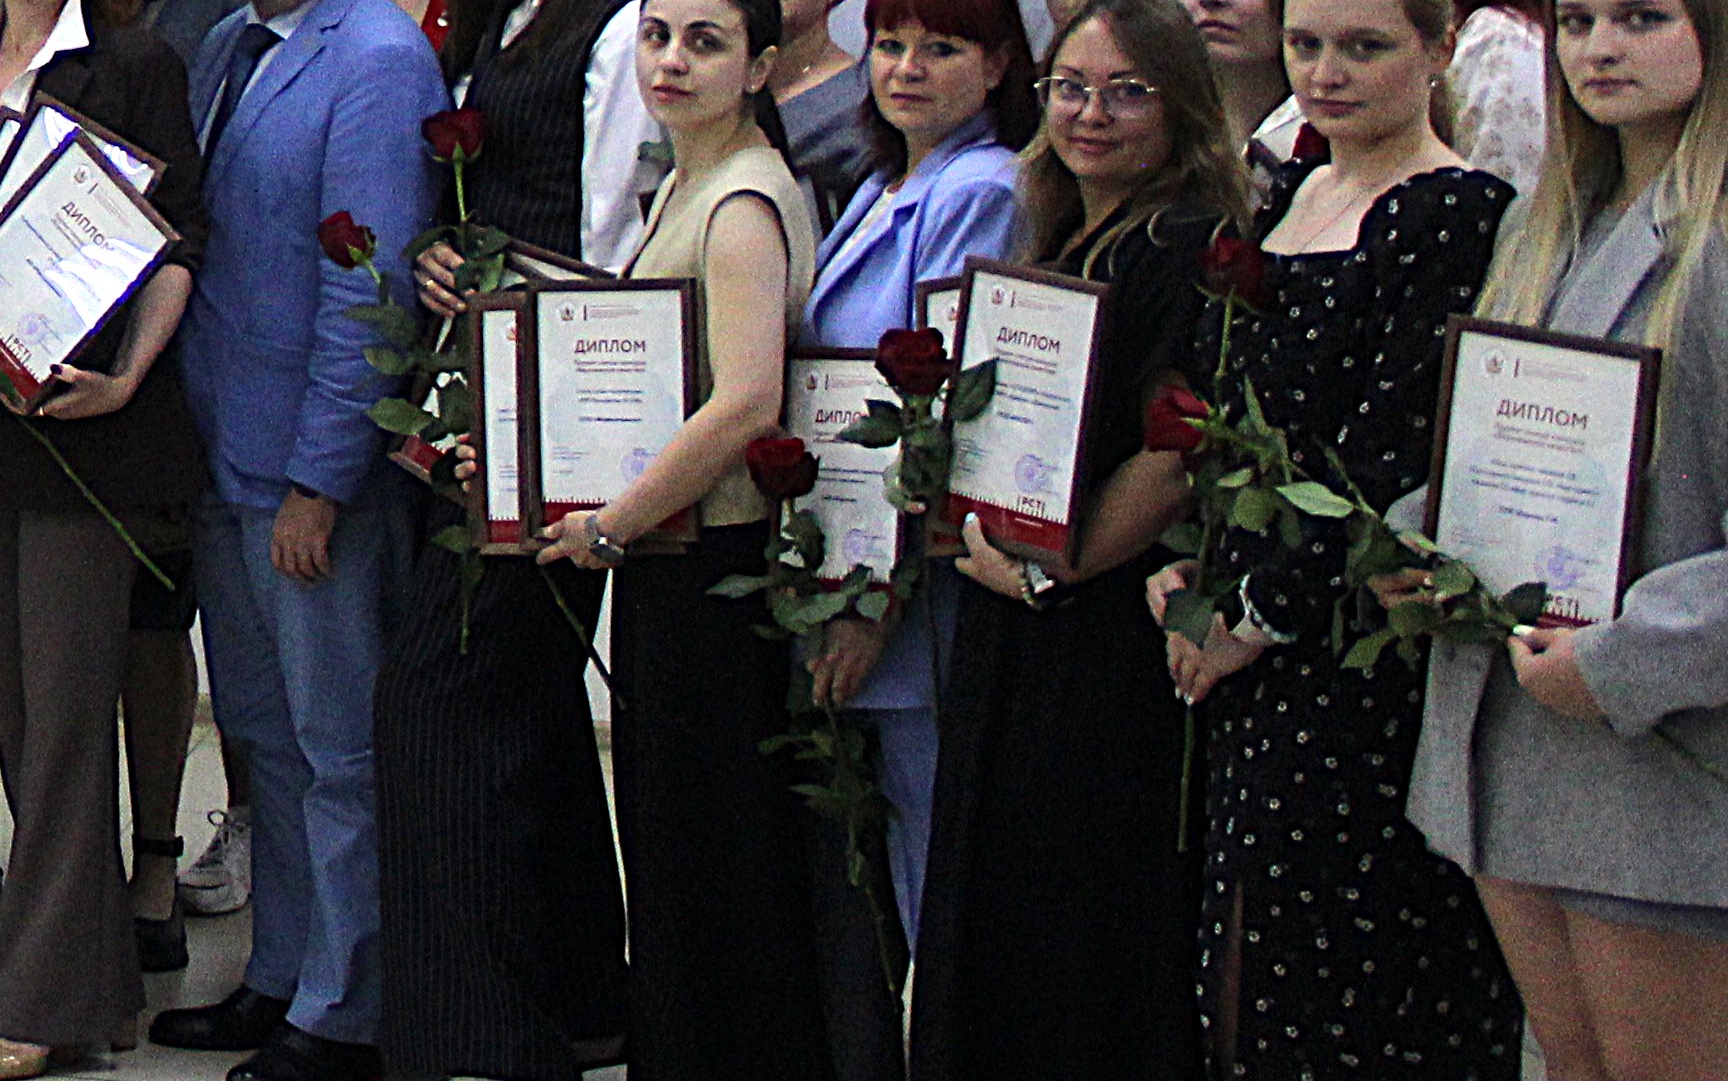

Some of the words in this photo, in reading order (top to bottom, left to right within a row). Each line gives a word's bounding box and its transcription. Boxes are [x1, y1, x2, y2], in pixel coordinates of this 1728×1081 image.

[61, 200, 115, 252] ДИПЛОМ
[574, 339, 646, 354] ДИПЛОМ
[997, 327, 1061, 355] ДИПЛОМ
[815, 409, 862, 424] ДИПЛО
[1496, 398, 1589, 430] ДИПЛОМ
